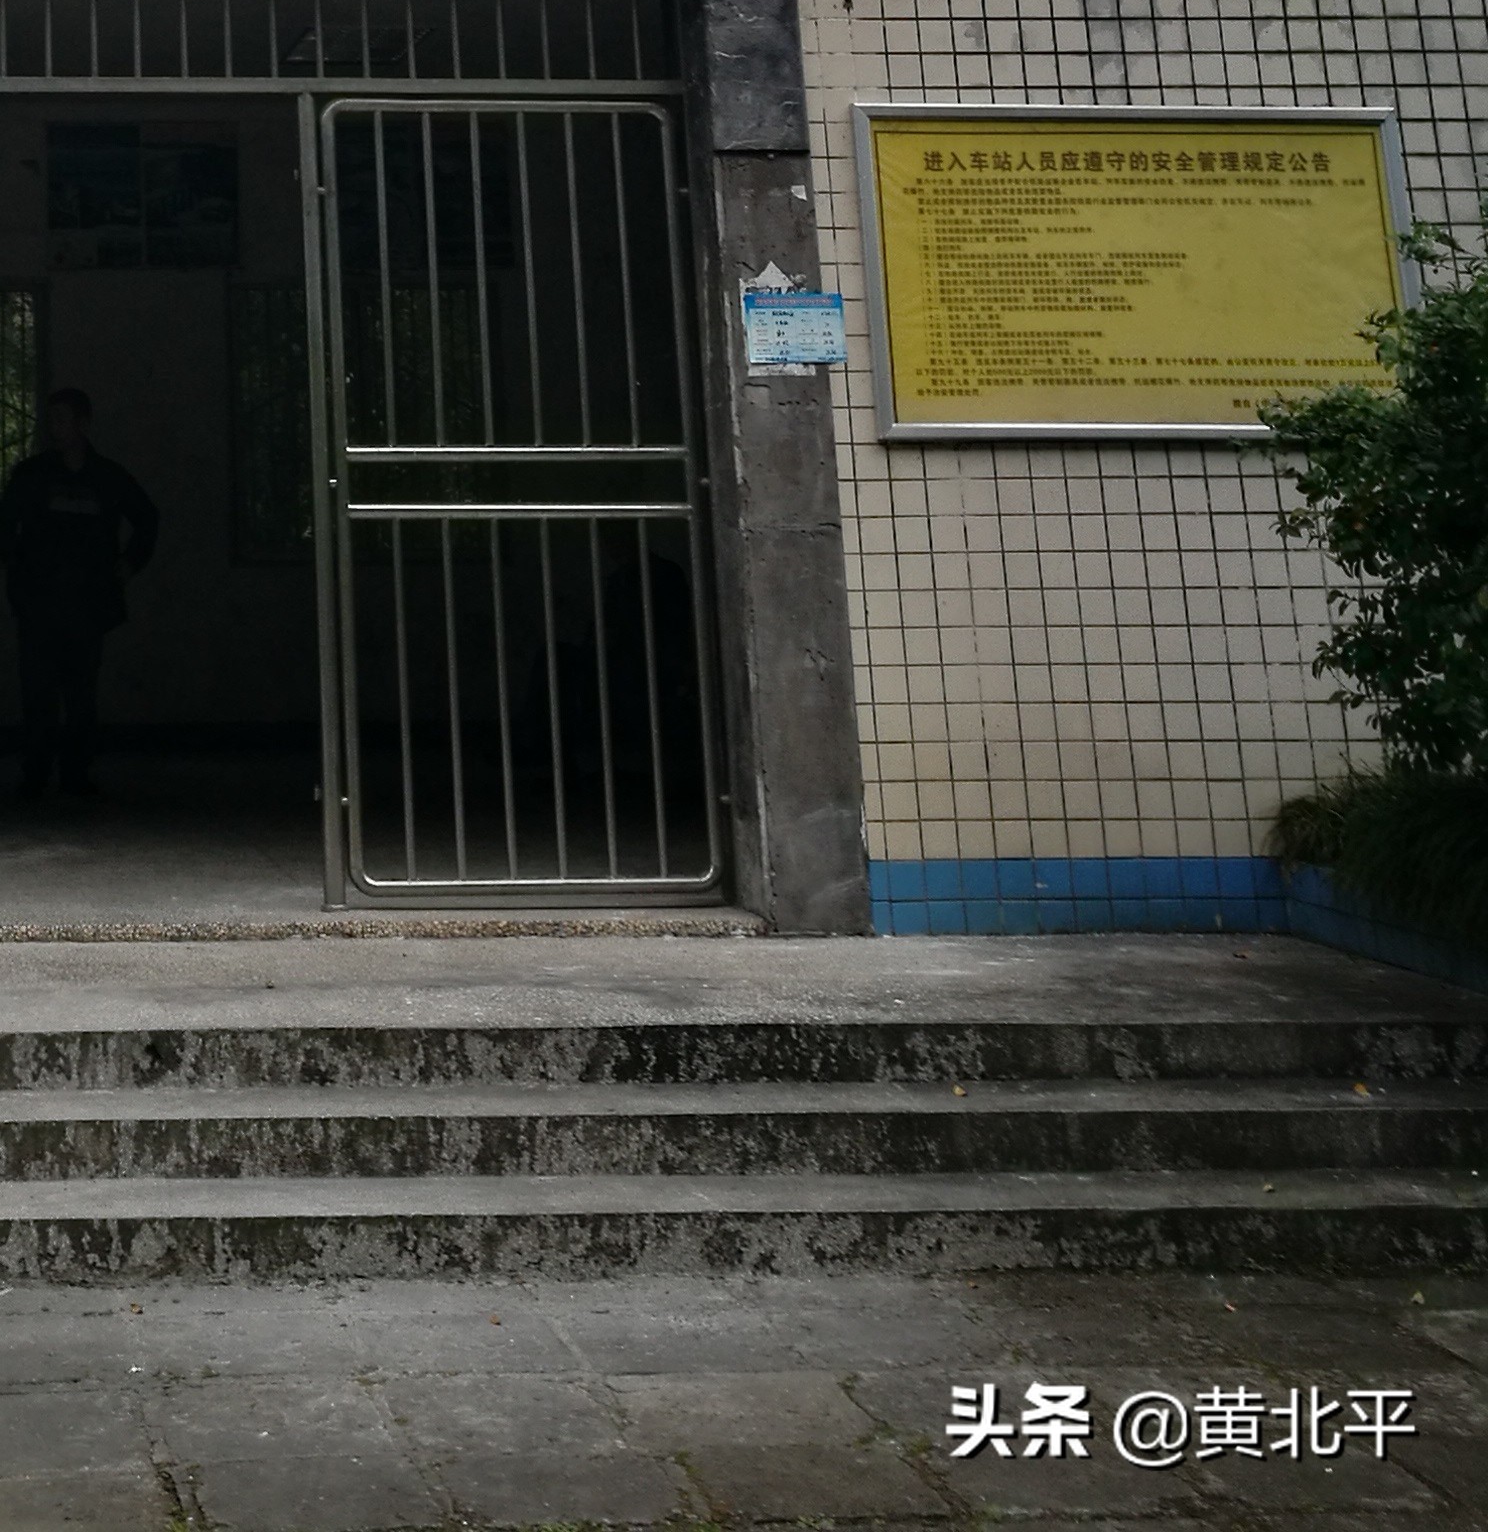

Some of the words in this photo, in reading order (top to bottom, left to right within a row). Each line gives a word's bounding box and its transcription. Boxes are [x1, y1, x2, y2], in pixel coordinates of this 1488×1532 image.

[923, 151, 1331, 173] 进入车站人员应遵守的安全管理规定公告
